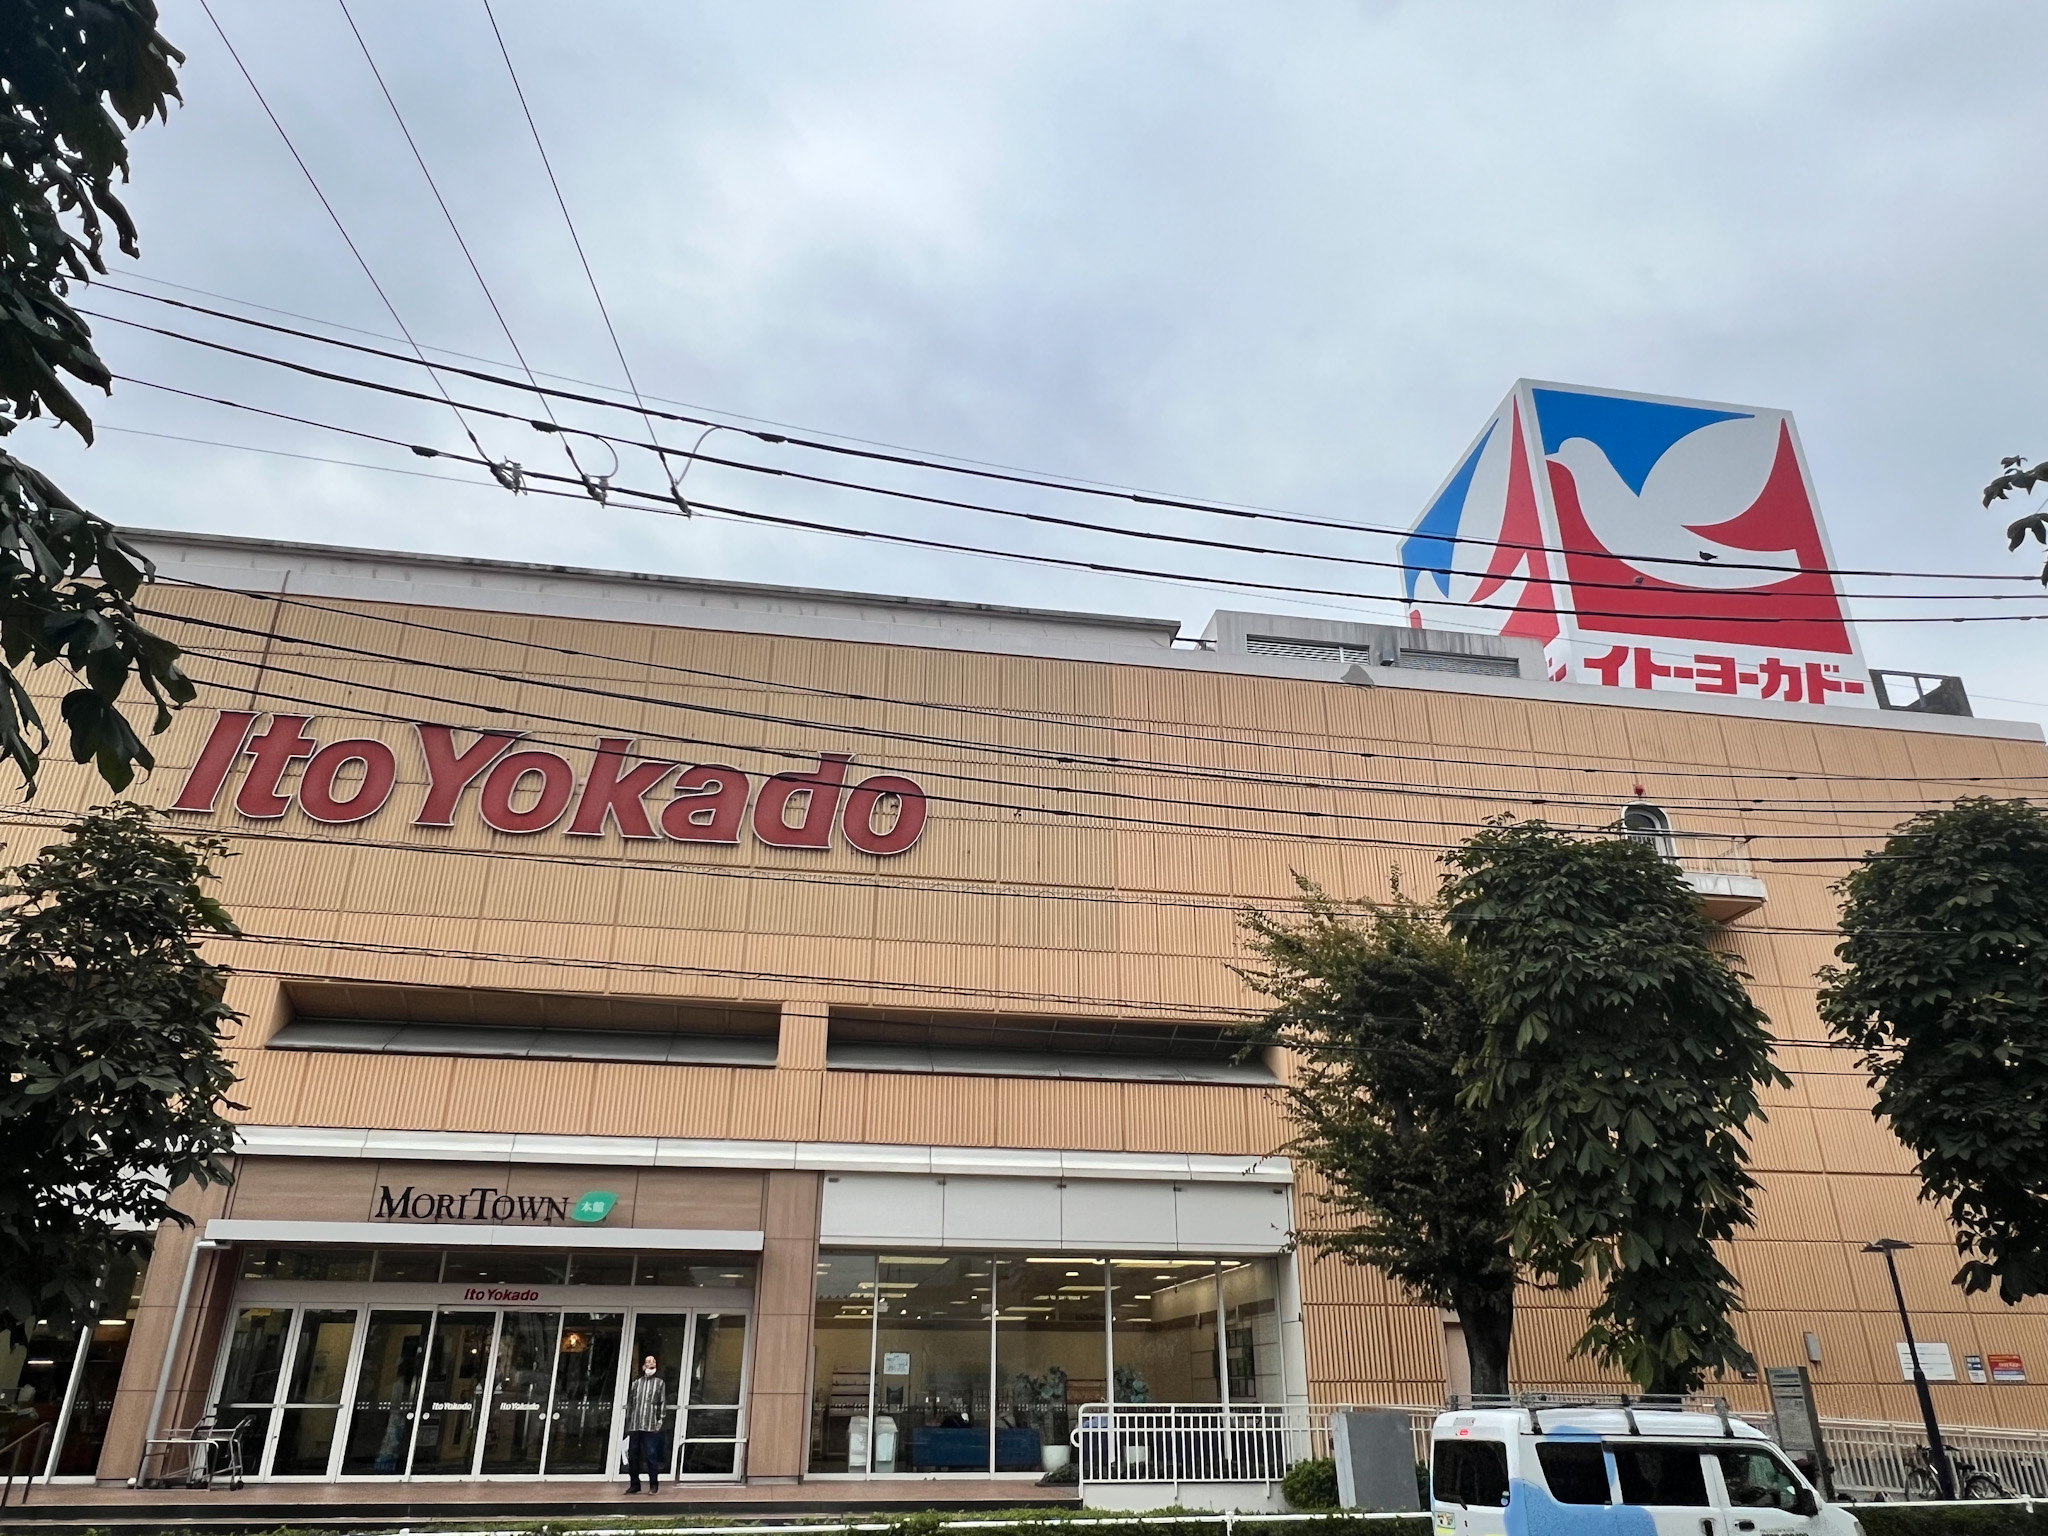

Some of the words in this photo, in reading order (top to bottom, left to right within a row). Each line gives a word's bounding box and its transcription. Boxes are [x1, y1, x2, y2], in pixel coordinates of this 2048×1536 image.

[1584, 645, 1865, 705] イトーヨーカドー
